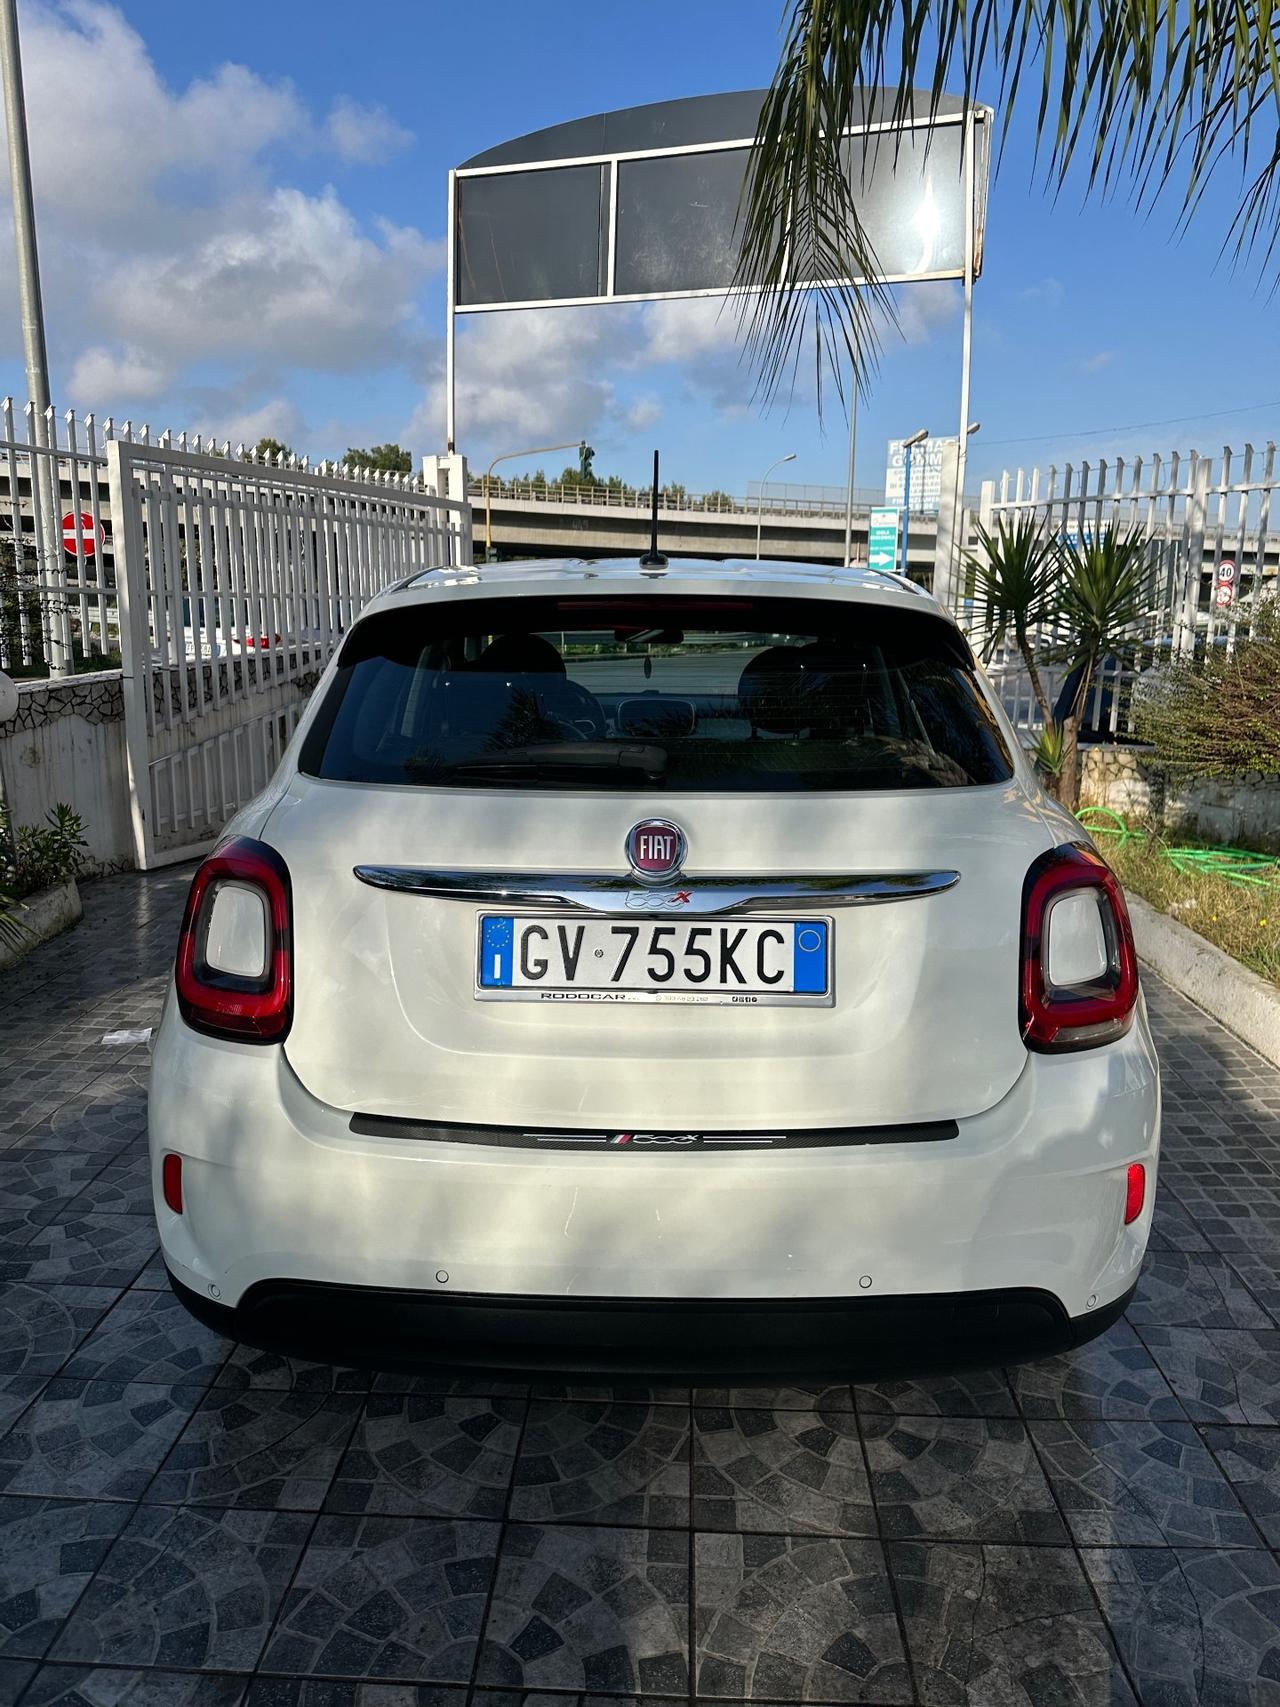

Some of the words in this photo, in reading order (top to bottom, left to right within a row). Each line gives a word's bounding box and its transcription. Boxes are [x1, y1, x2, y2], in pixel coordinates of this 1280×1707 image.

[1220, 567, 1232, 578] 40
[640, 835, 673, 860] FIAT
[520, 924, 586, 981] GV
[610, 925, 785, 985] 755KC
[540, 992, 626, 1001] RODOCAR
